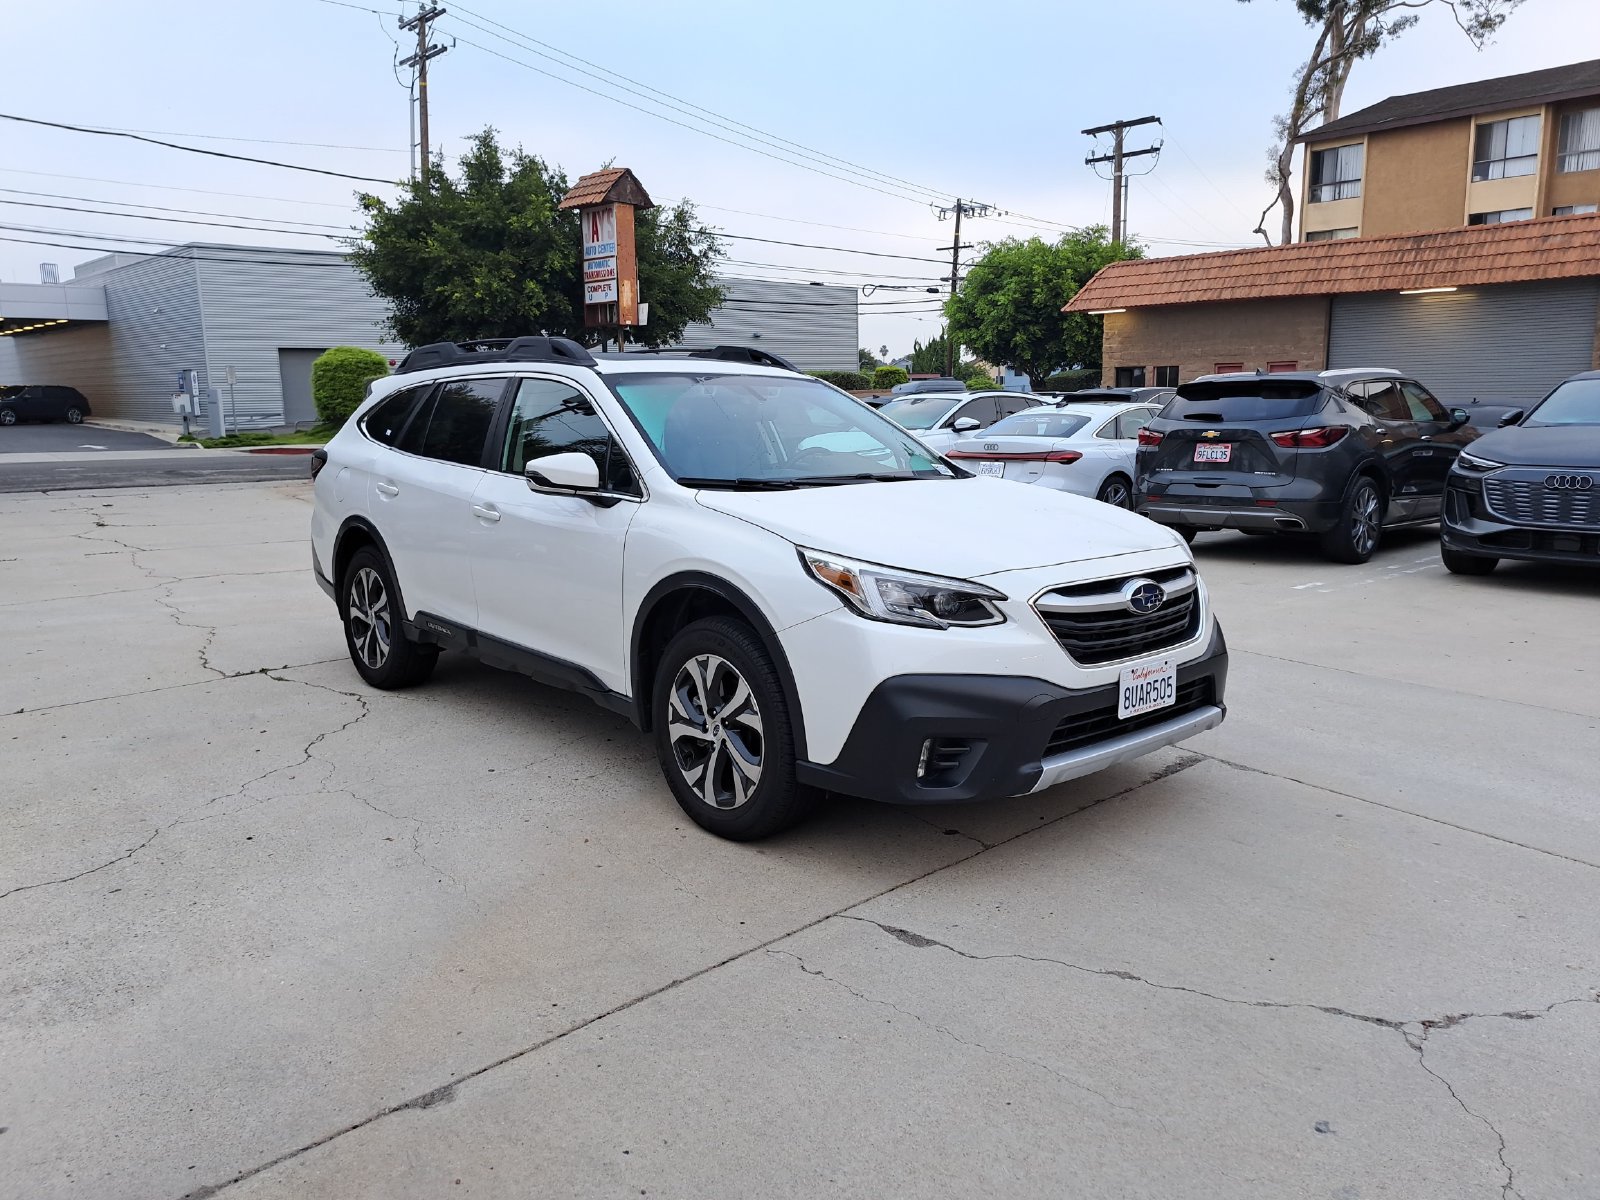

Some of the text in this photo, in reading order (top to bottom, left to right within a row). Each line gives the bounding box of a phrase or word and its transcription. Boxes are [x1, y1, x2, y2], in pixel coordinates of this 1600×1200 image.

[585, 243, 615, 256] AUTO CENTER
[587, 260, 611, 270] AUTOMATIC
[587, 284, 612, 294] COMPLETE
[1123, 675, 1173, 710] 8UAR505
